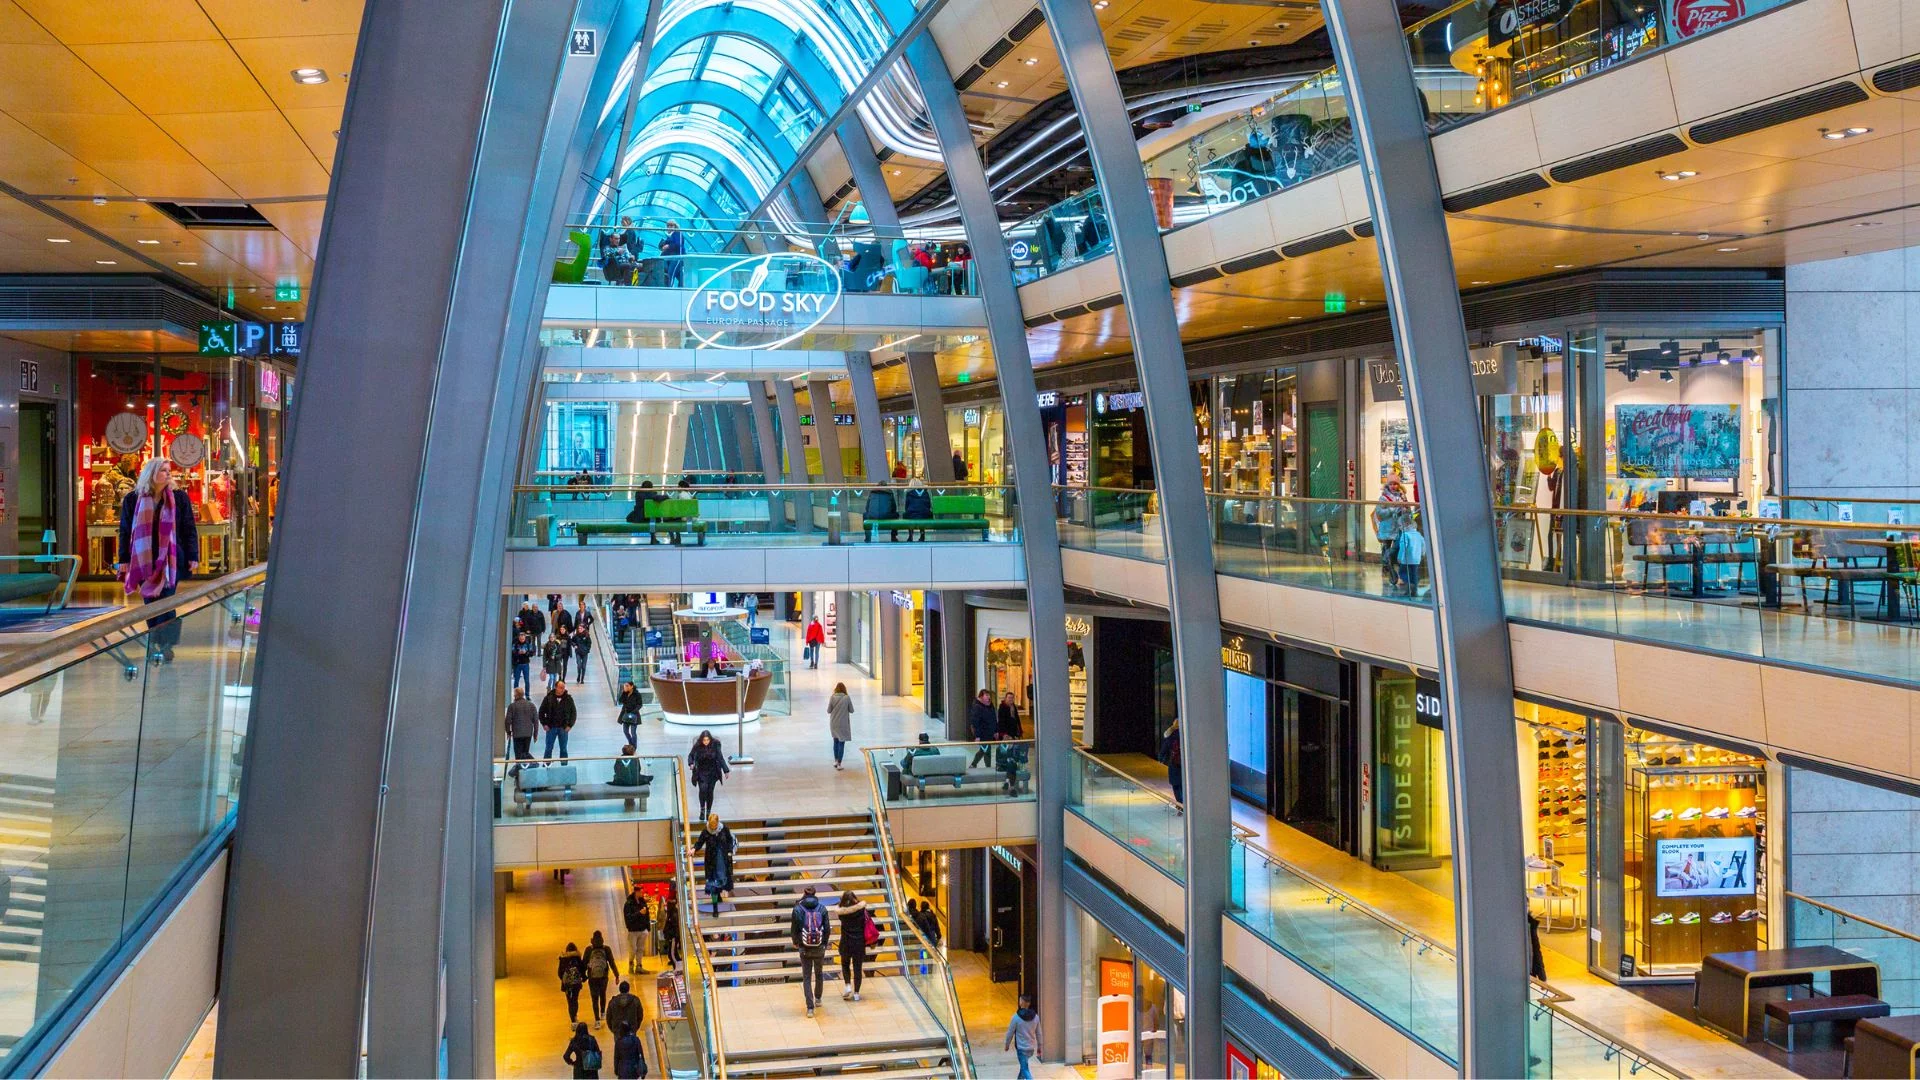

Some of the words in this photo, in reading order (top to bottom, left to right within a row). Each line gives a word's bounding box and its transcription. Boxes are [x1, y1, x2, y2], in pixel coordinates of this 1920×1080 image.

[1518, 0, 1560, 20] STRE
[1687, 8, 1728, 26] Pizza
[706, 287, 775, 312] FOOD
[782, 292, 826, 313] SKY
[706, 318, 744, 326] EUROPA
[748, 318, 789, 327] PASSAGE
[246, 325, 265, 347] P
[1373, 362, 1395, 384] Udo
[1037, 393, 1056, 407] HERS
[1627, 455, 1650, 467] Udo
[1715, 455, 1726, 465] &
[1729, 456, 1754, 466] more
[1222, 647, 1251, 671] OLLISTER
[1416, 693, 1441, 716] SID
[1394, 694, 1412, 840] SIDESTEP
[1109, 968, 1130, 979] Final
[1111, 978, 1129, 988] Sale
[1104, 1048, 1129, 1063] Sal
